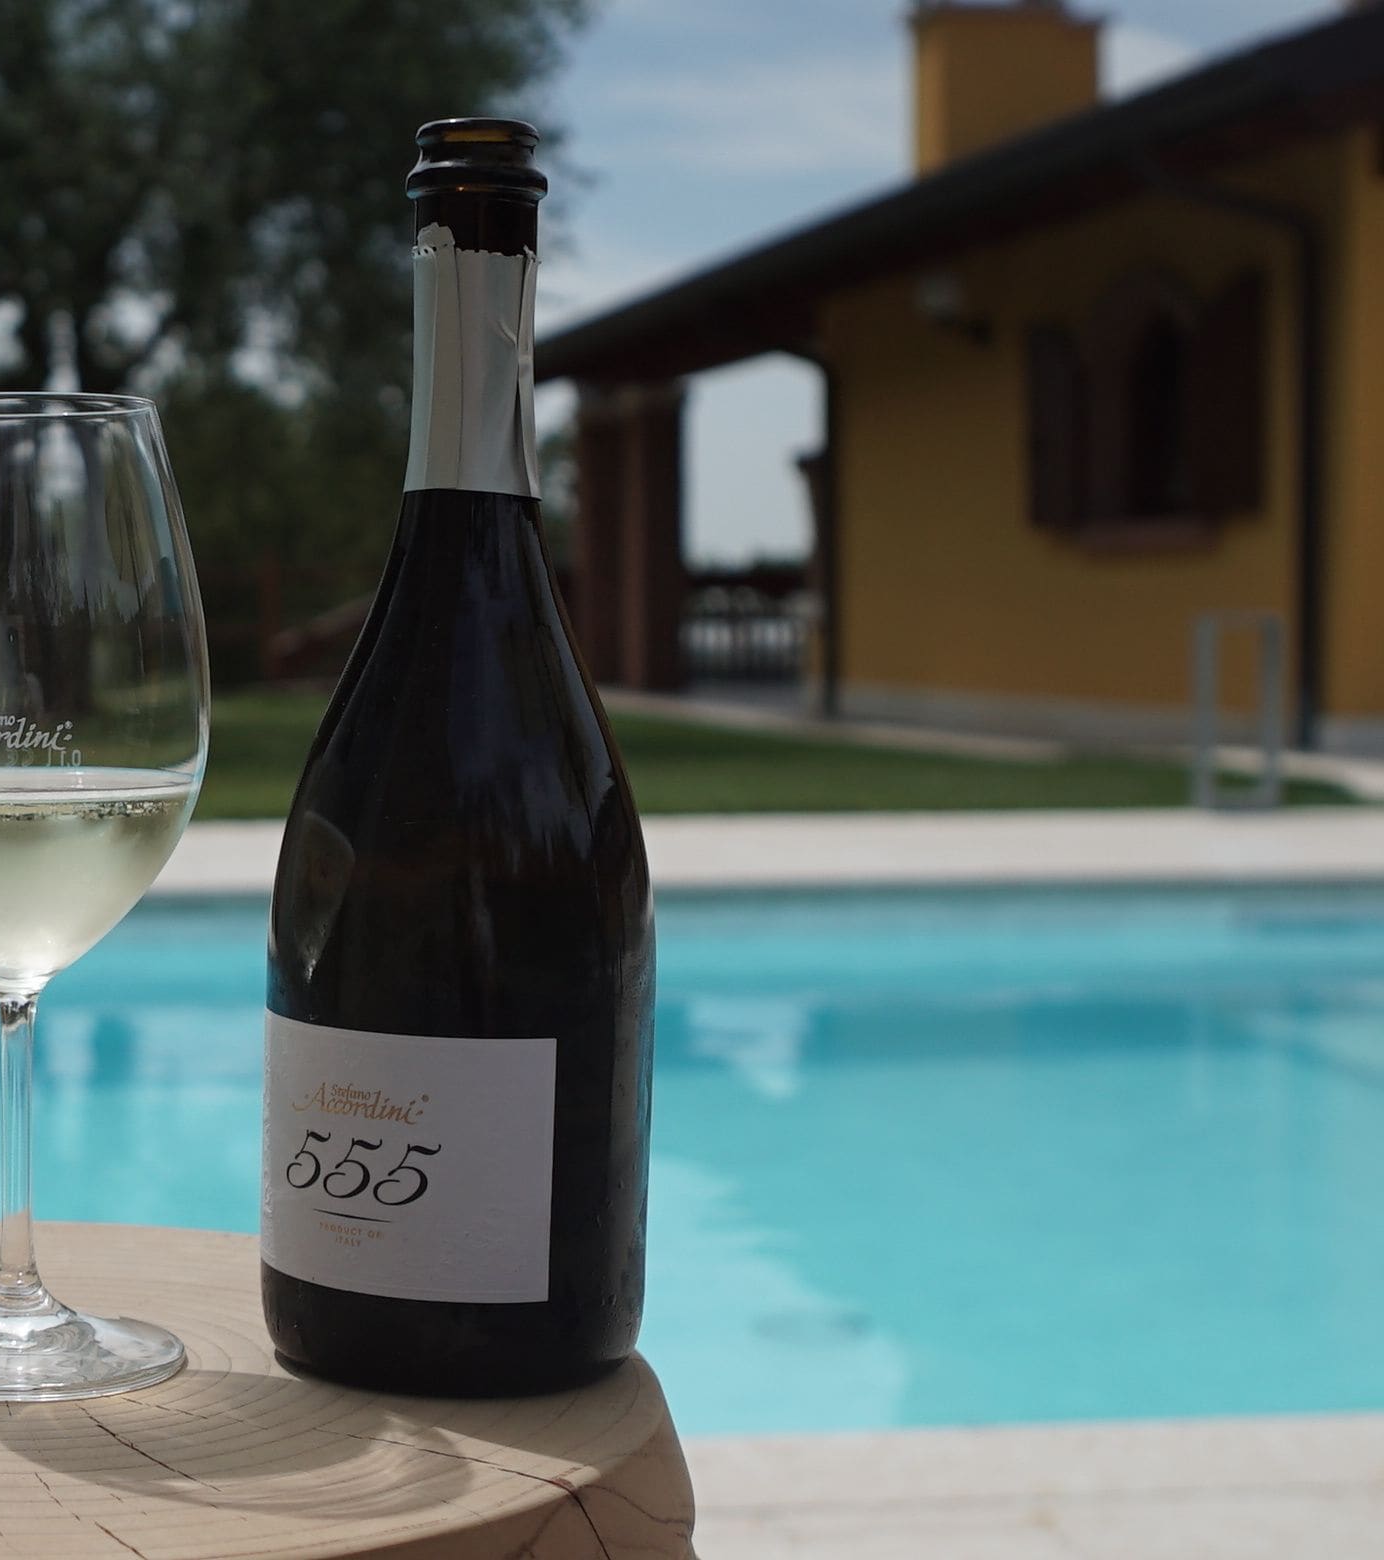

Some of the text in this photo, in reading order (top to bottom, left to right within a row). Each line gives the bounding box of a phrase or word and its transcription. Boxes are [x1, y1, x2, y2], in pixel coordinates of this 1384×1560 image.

[292, 1082, 418, 1125] Accordini
[330, 1084, 372, 1101] Stefano
[286, 1129, 442, 1206] 555
[335, 1235, 361, 1247] ITALY
